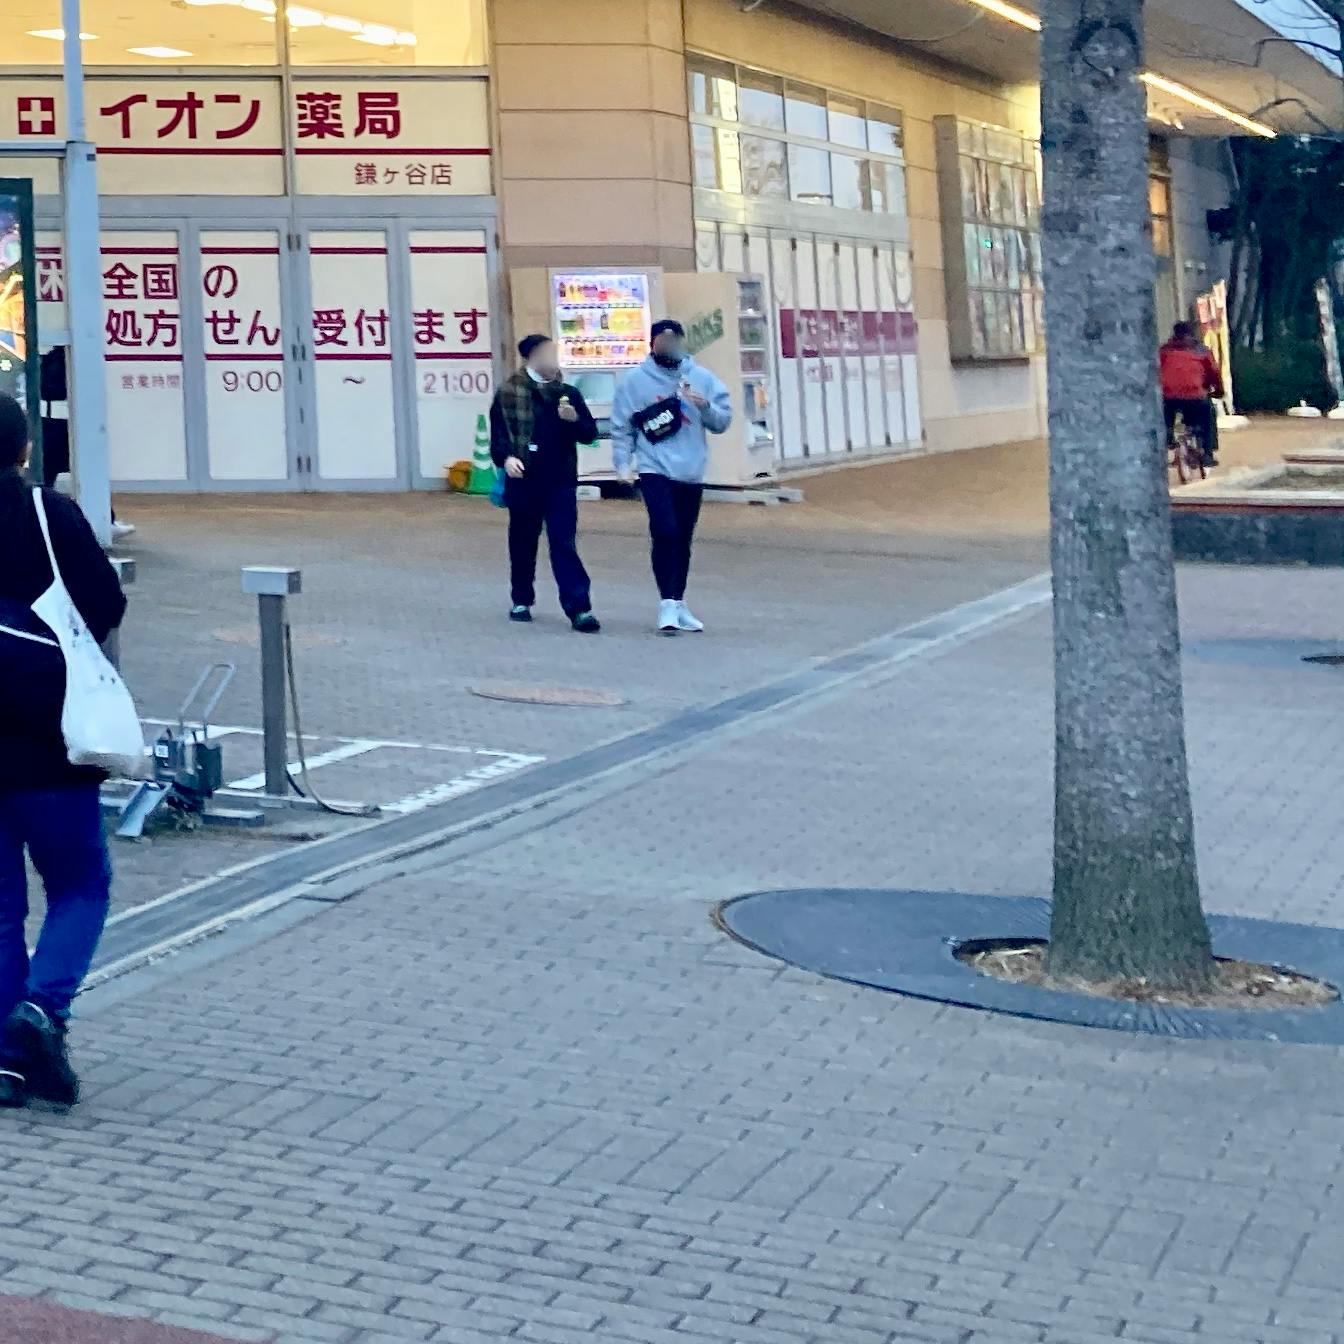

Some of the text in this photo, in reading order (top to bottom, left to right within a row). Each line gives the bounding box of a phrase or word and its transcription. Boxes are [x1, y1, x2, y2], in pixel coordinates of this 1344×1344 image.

[102, 261, 239, 300] 全国の
[105, 308, 489, 348] 処方せん受付ます
[222, 370, 283, 393] 9:00
[423, 372, 490, 395] 21:00
